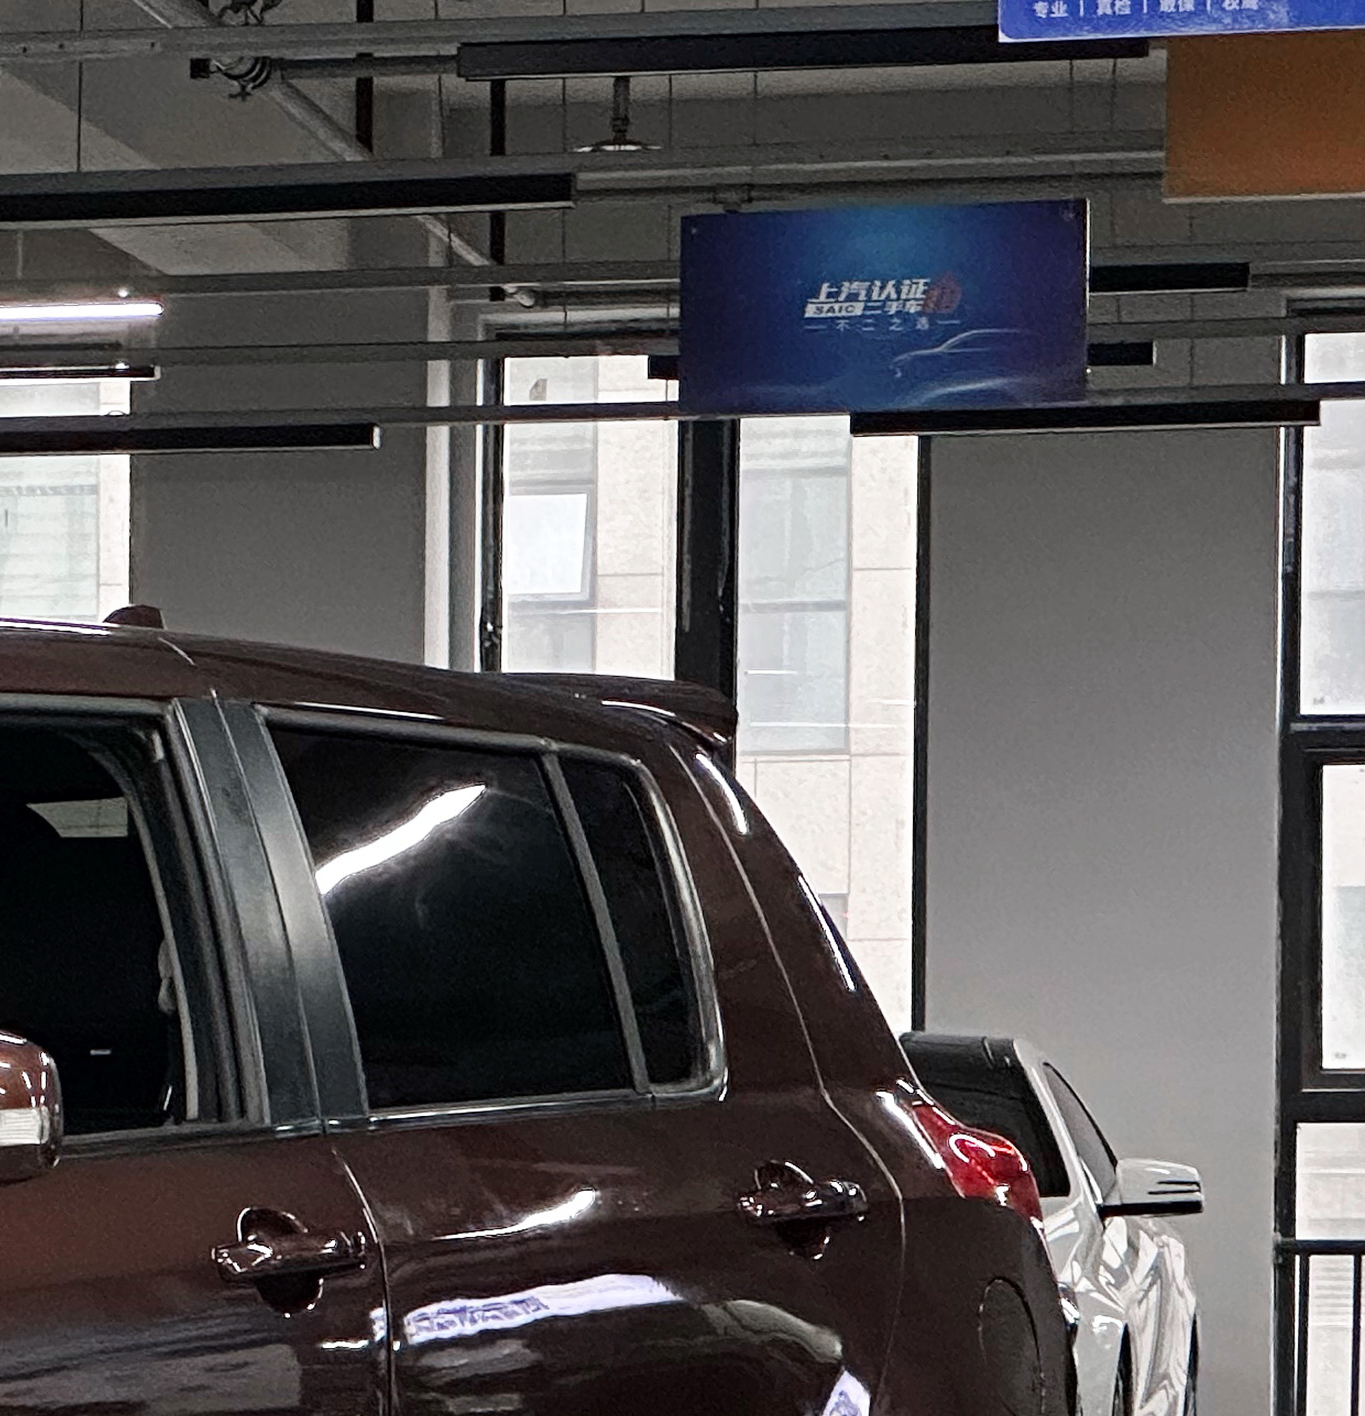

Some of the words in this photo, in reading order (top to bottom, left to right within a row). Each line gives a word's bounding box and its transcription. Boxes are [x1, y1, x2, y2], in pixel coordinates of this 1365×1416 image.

[807, 278, 931, 303] 上汽认证
[812, 305, 856, 316] SAIC
